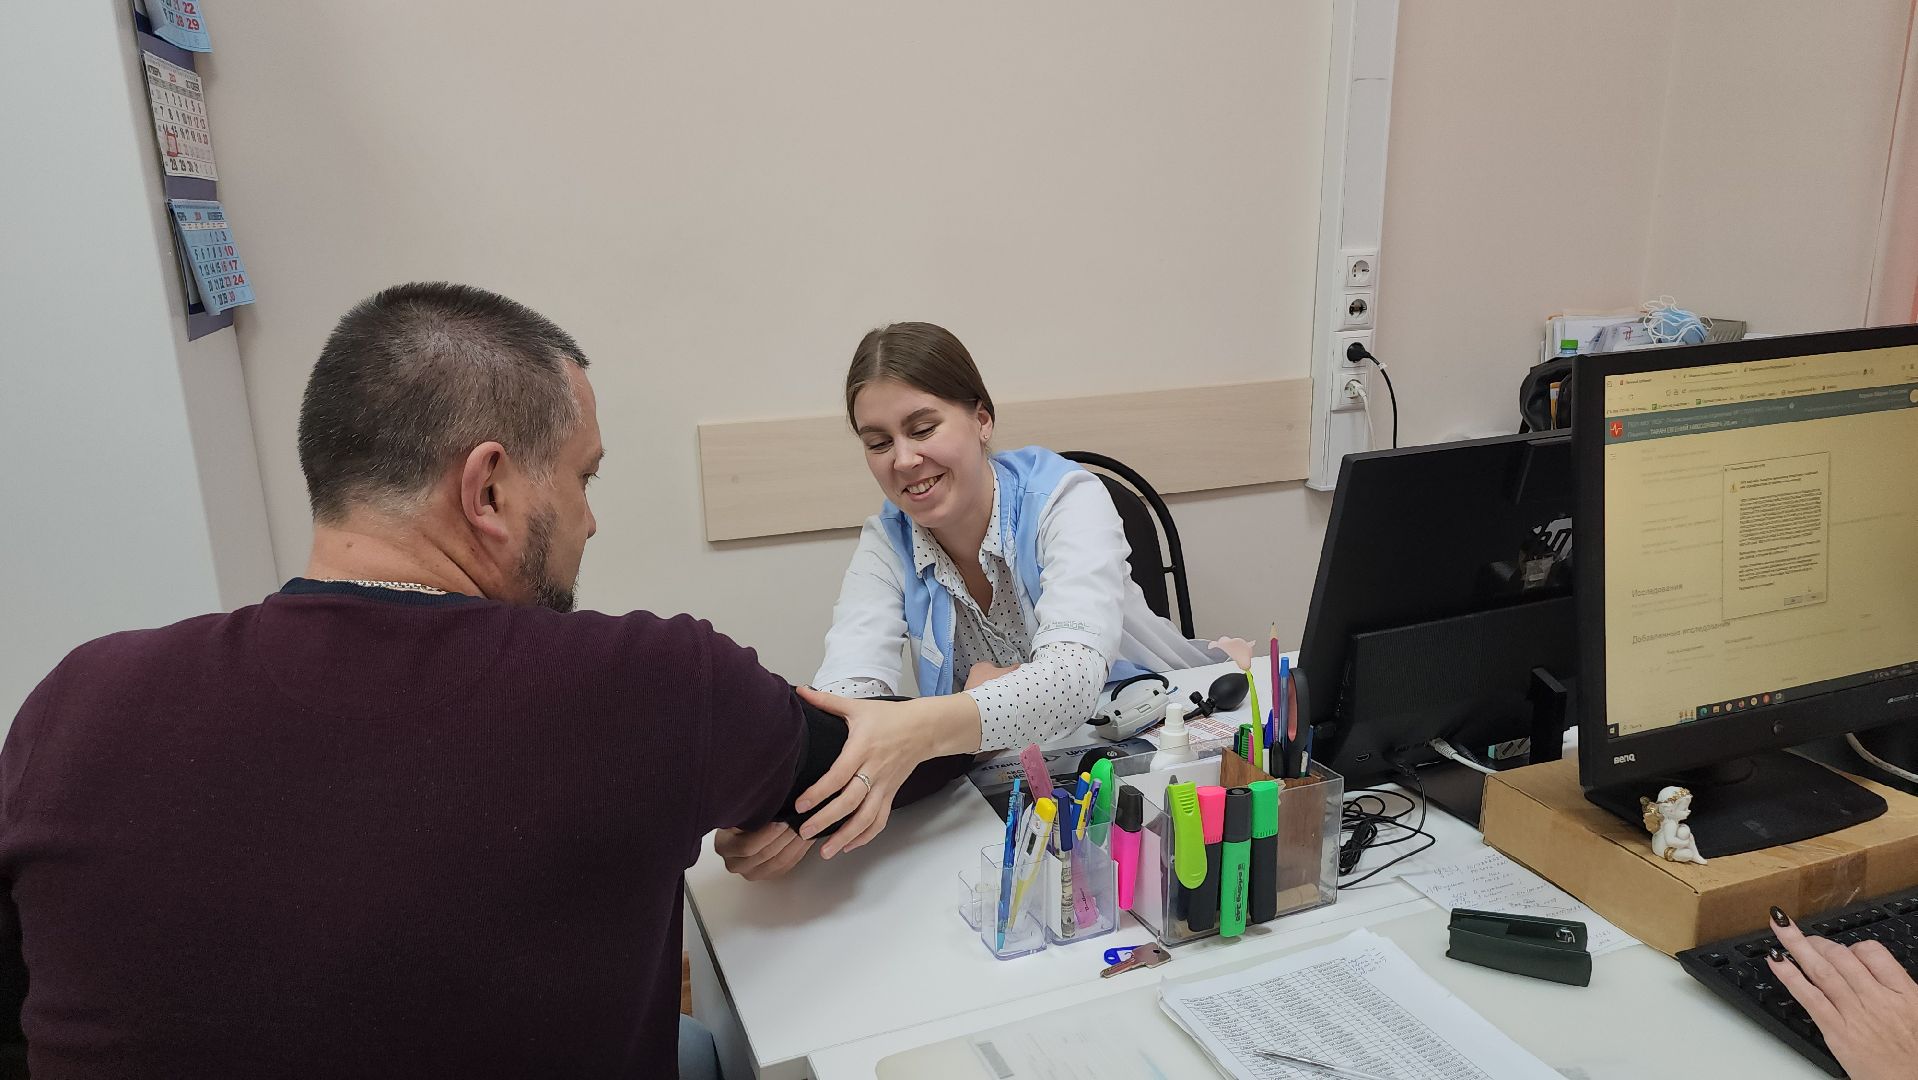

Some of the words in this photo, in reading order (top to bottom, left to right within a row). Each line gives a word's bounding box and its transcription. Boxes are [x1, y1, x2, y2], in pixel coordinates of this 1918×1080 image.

[182, 1, 197, 14] 22
[186, 17, 200, 30] 29
[224, 245, 234, 256] 10
[229, 259, 238, 271] 17
[233, 274, 245, 285] 24
[1613, 753, 1636, 765] BenQ
